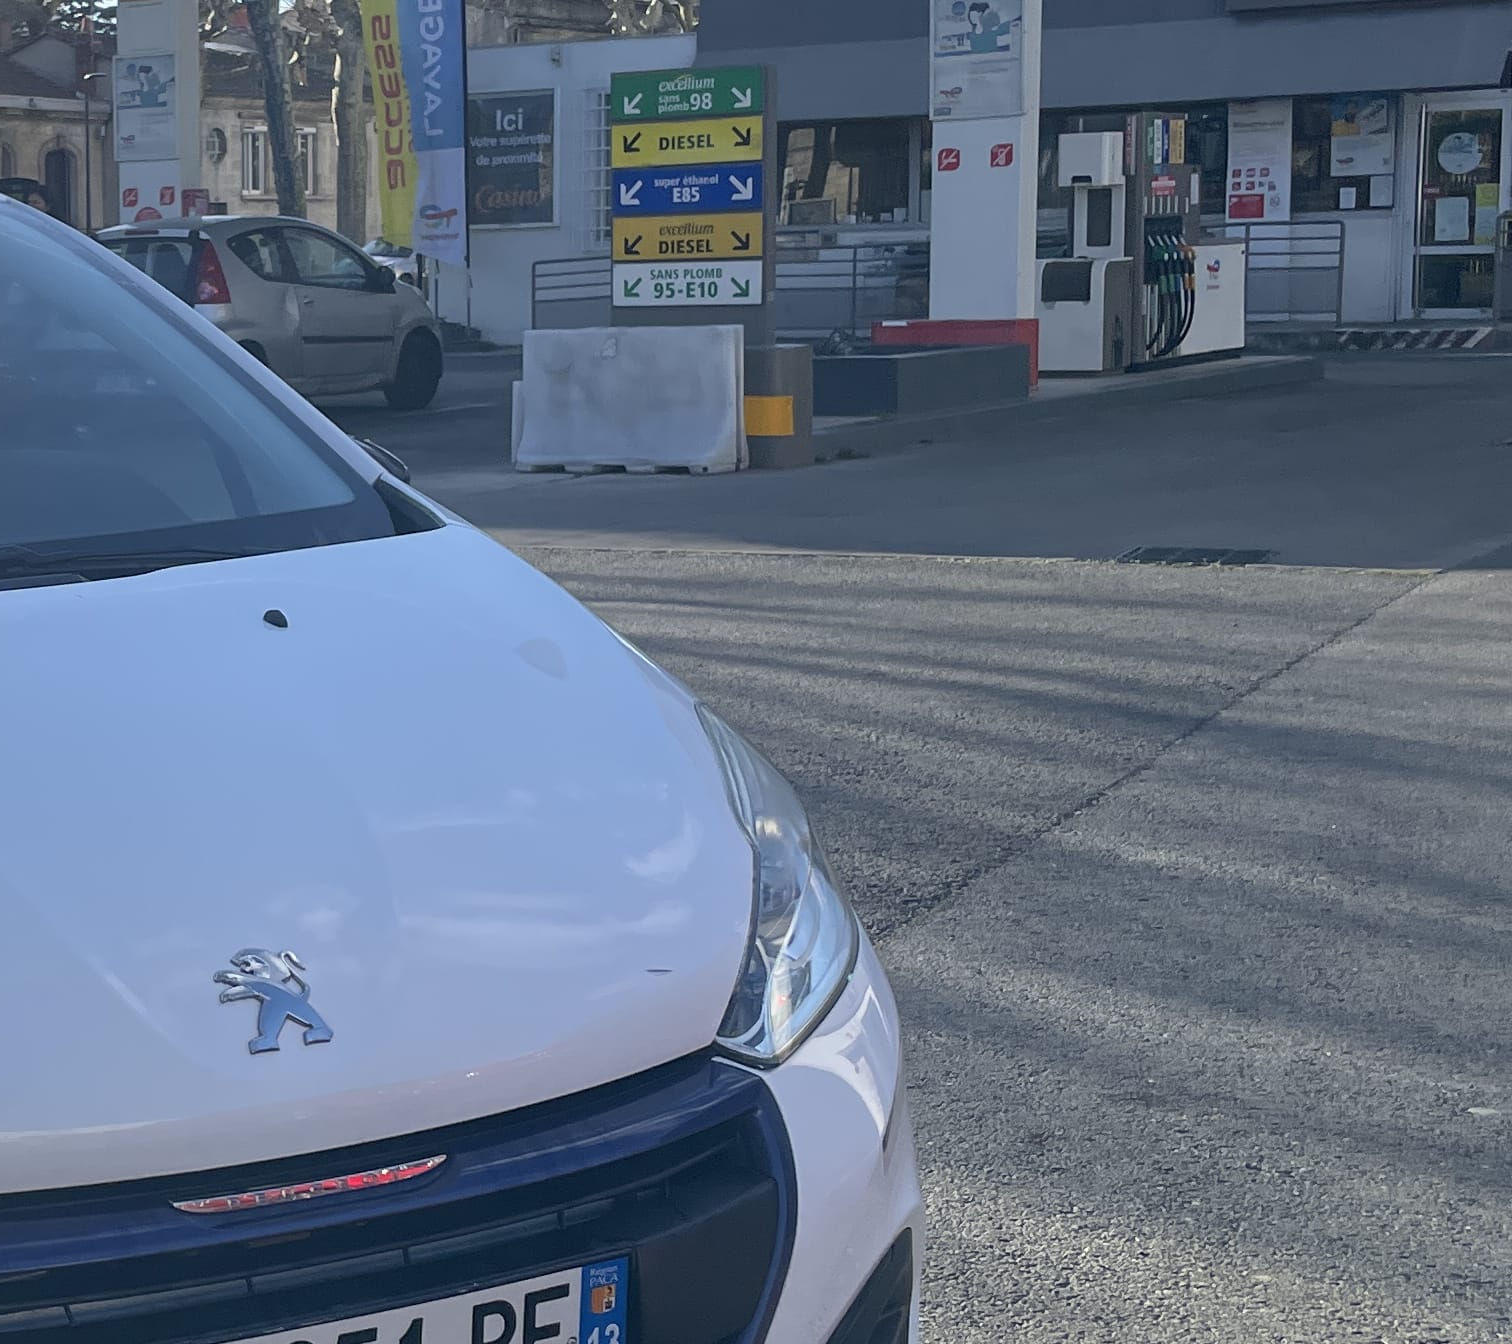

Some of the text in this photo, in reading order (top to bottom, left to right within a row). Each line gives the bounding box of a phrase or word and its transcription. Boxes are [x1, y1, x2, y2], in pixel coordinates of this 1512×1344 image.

[658, 77, 715, 92] excellium
[658, 94, 680, 105] sans
[658, 92, 713, 115] plomb 98
[495, 107, 525, 131] Ici
[659, 134, 715, 151] DIESEL
[654, 173, 719, 189] super éthanol
[672, 187, 701, 203] E85
[659, 221, 715, 236] excellium
[658, 239, 714, 255] DIESEL
[650, 267, 724, 281] SANS PLOMB
[653, 281, 719, 300] 95-E10
